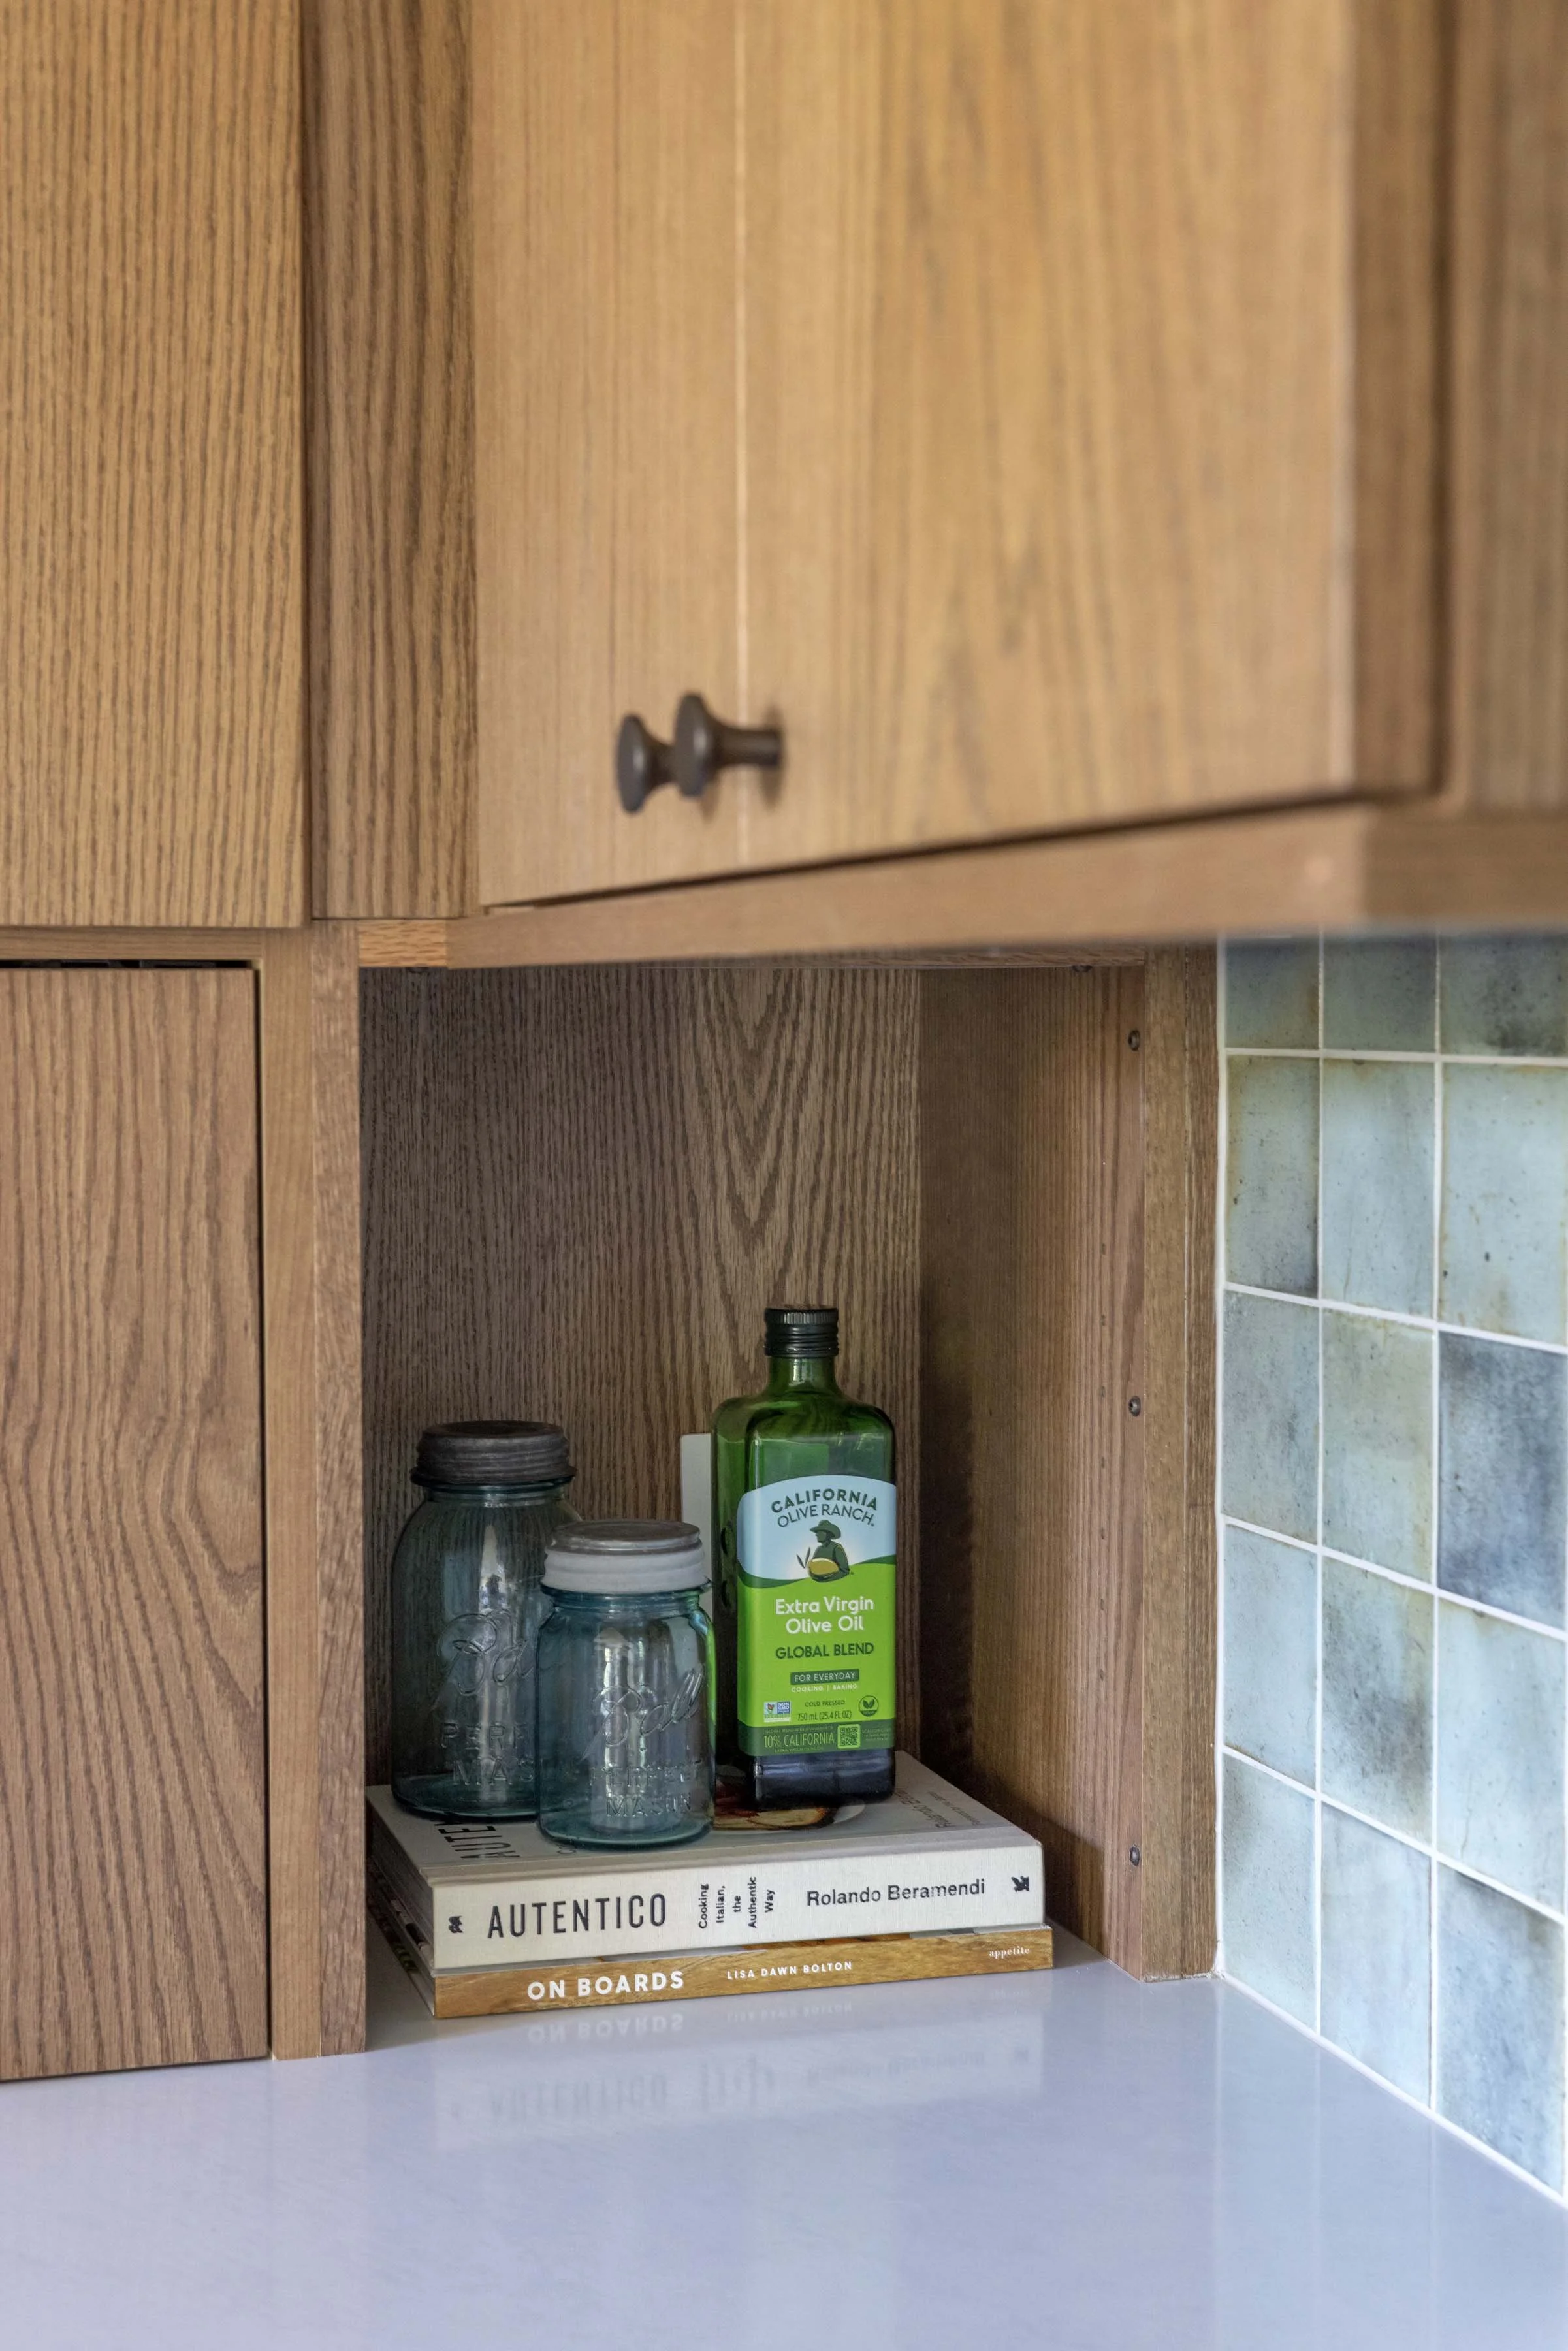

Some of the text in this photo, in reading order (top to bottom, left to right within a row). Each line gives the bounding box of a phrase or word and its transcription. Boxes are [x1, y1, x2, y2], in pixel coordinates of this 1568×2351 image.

[771, 1488, 878, 1514] CALIFORNIA
[777, 1503, 816, 1527] OLIVE
[775, 1596, 874, 1616] Extra Virgin
[786, 1615, 864, 1634] Olive Oil
[775, 1642, 874, 1659] GLOBAL BLEND
[814, 1671, 856, 1682] EVERYDAY
[797, 1712, 808, 1721] 750
[835, 1710, 842, 1719] FL
[763, 1731, 835, 1748] 10% CALIFORNIA
[747, 1876, 756, 1928] Authentic
[764, 1889, 775, 1913] Way
[807, 1878, 985, 1907] Rolando Beramendi
[698, 1883, 709, 1929] Cooking
[716, 1885, 726, 1923] Italian,
[732, 1895, 741, 1913] the
[487, 1893, 667, 1939] AUTENTICO
[989, 1944, 1031, 1959] appetite
[727, 1961, 853, 1980] LISA DAWN BOLTON
[527, 1970, 684, 2000] ON BOARDS
